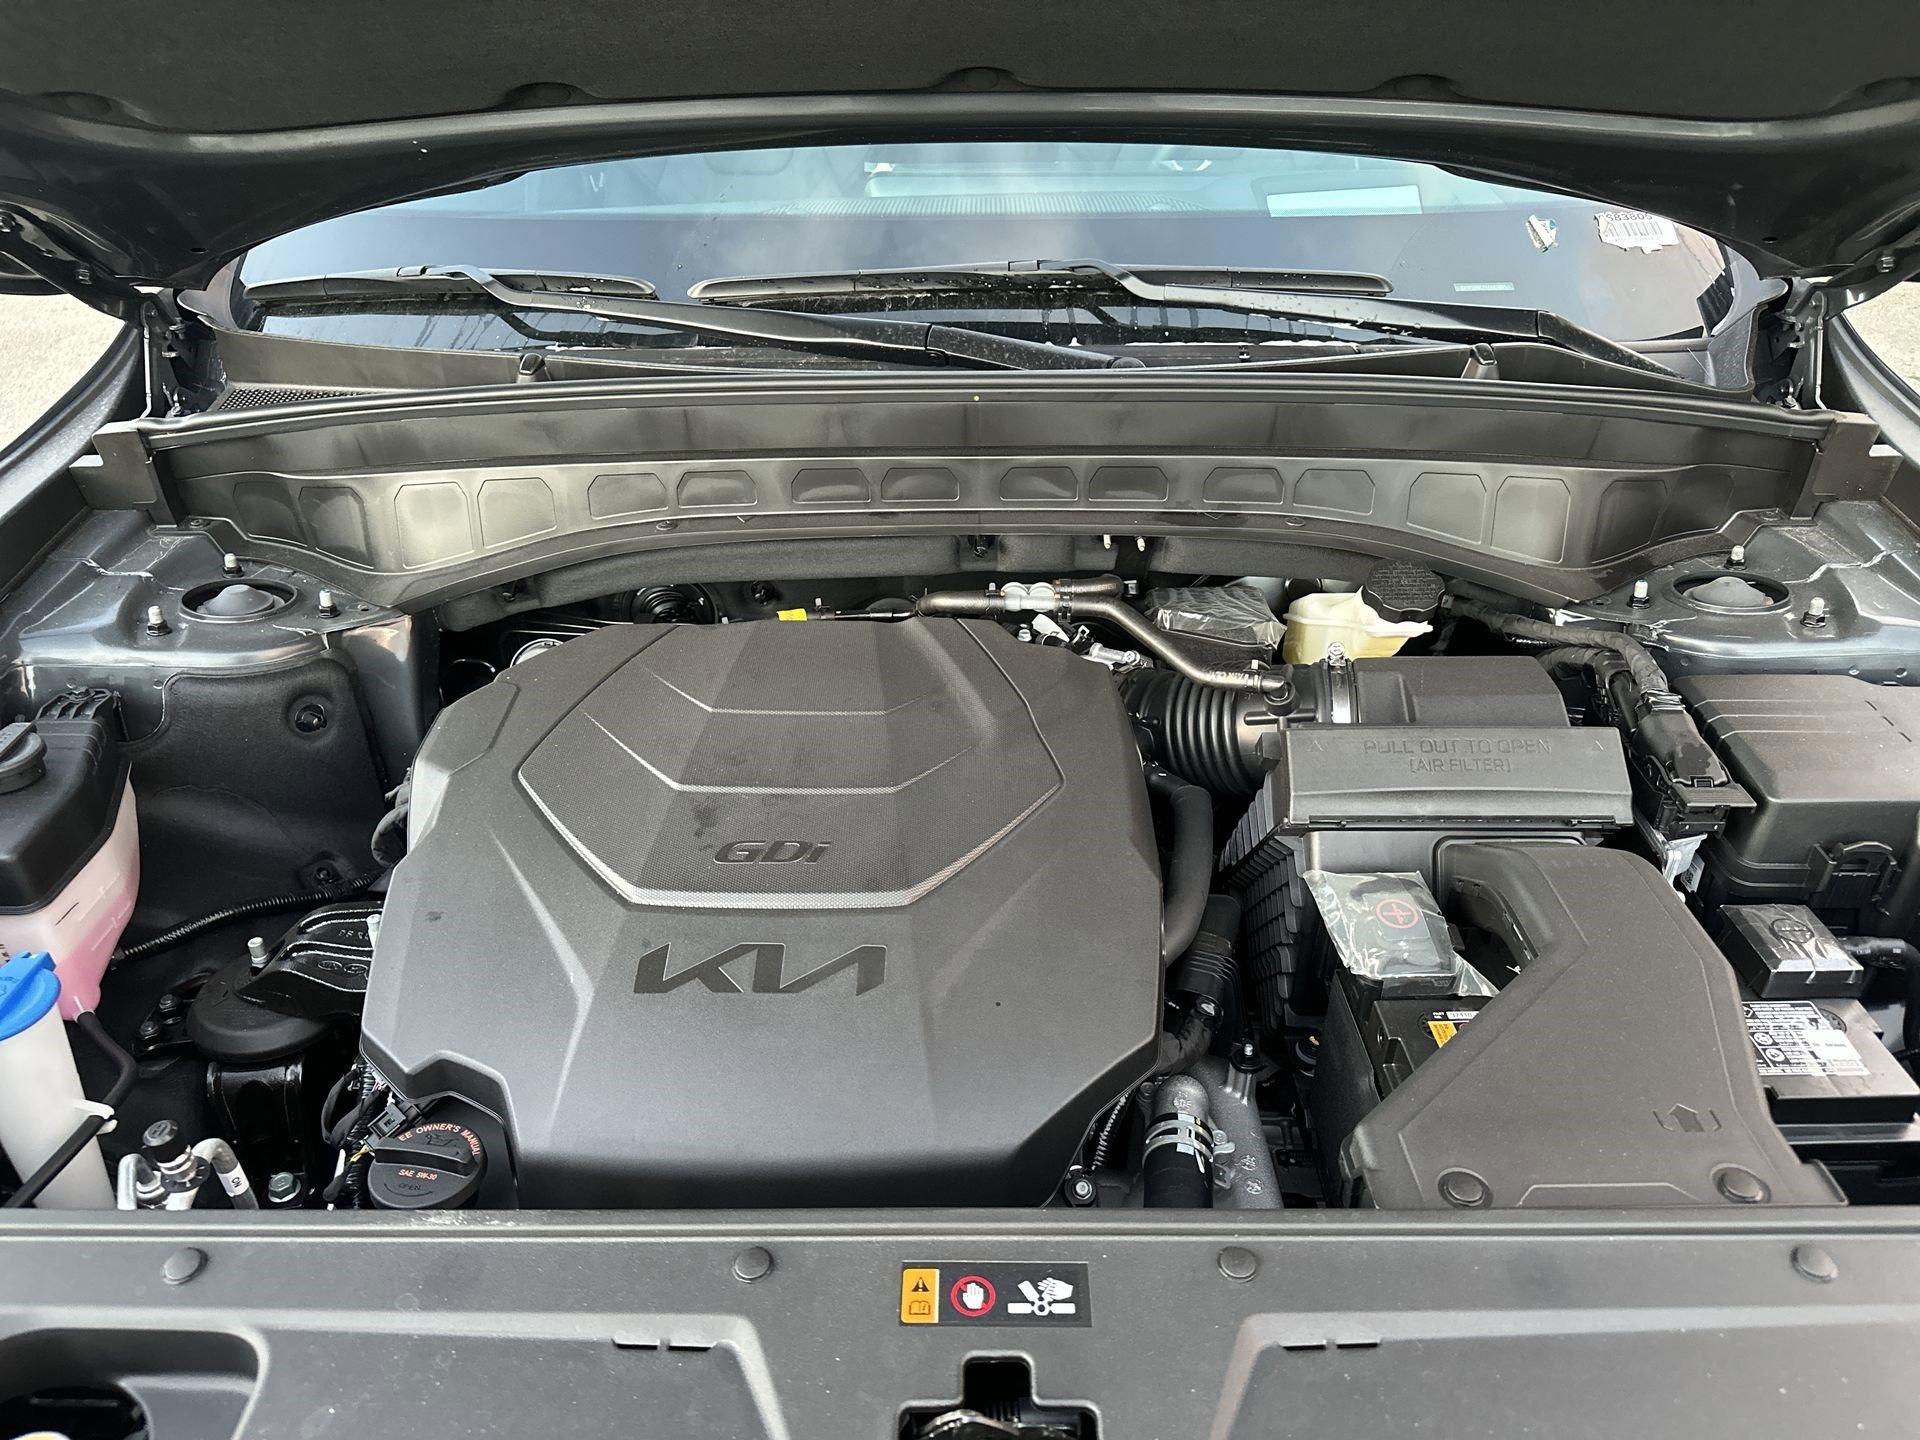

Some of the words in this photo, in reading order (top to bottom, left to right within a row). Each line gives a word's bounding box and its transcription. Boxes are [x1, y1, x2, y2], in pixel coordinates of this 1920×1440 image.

[1363, 739, 1414, 754] PULL
[1420, 738, 1461, 754] OUT
[1463, 739, 1491, 754] TO
[1497, 739, 1551, 754] OPEN
[713, 840, 831, 865] GDi
[633, 942, 887, 996] KIA
[416, 1123, 461, 1134] OWNER'S
[461, 1129, 481, 1157] MANUAL
[398, 1169, 414, 1178] SAE
[416, 1171, 438, 1181] 5W-30
[398, 1183, 421, 1191] OPEN
